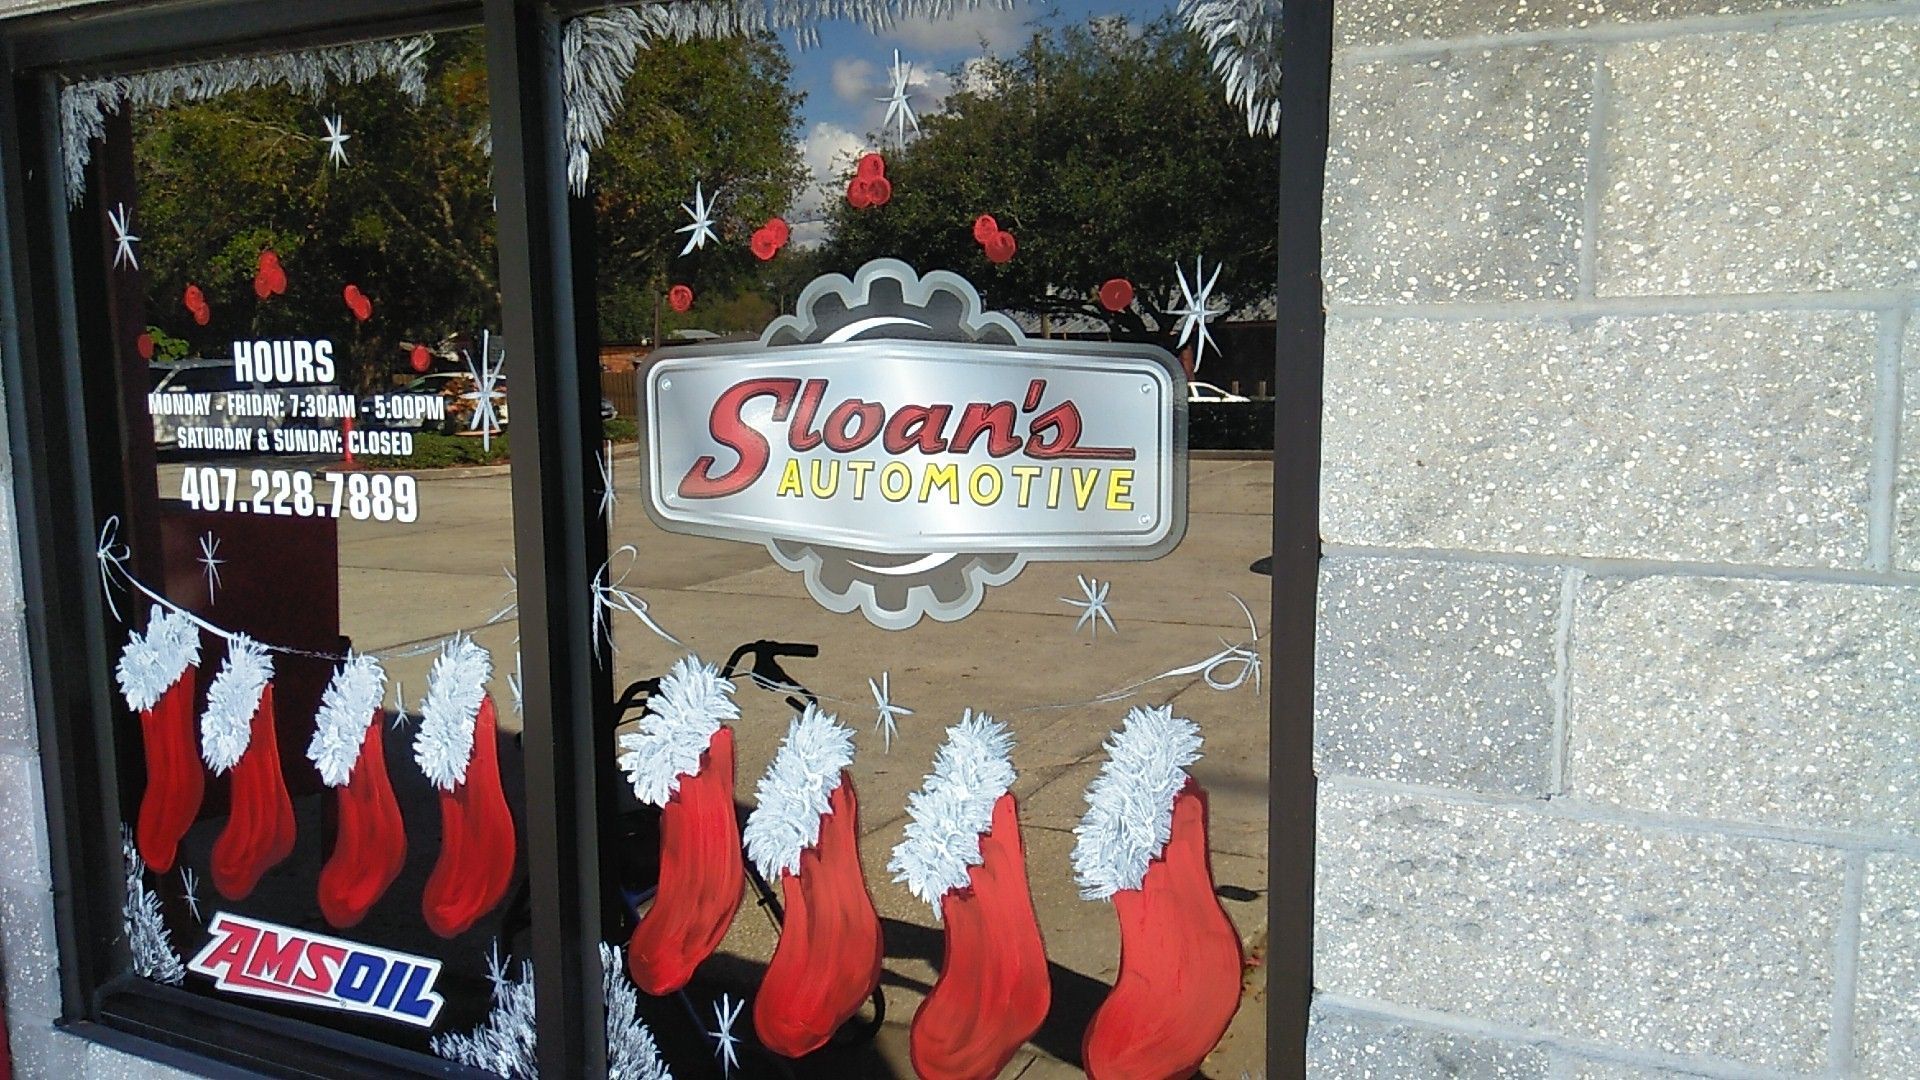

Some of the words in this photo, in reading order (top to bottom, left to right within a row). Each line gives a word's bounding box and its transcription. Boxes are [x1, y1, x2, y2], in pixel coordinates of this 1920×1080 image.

[233, 339, 335, 383] HOURS
[148, 393, 211, 416] MONDAY
[228, 394, 285, 417] FRIDAY:
[290, 394, 355, 418] 7:30AM
[375, 395, 445, 421] 5:00PM
[177, 427, 252, 451] SATURDAY
[257, 429, 269, 450] &
[274, 428, 343, 454] SUNDAY:
[348, 430, 413, 456] CLOSED
[677, 377, 1136, 500] Sloan's
[181, 467, 418, 523] 407.228.7889
[776, 458, 1135, 512] AUTOMOTIVE
[200, 919, 435, 1019] AMSOIL
